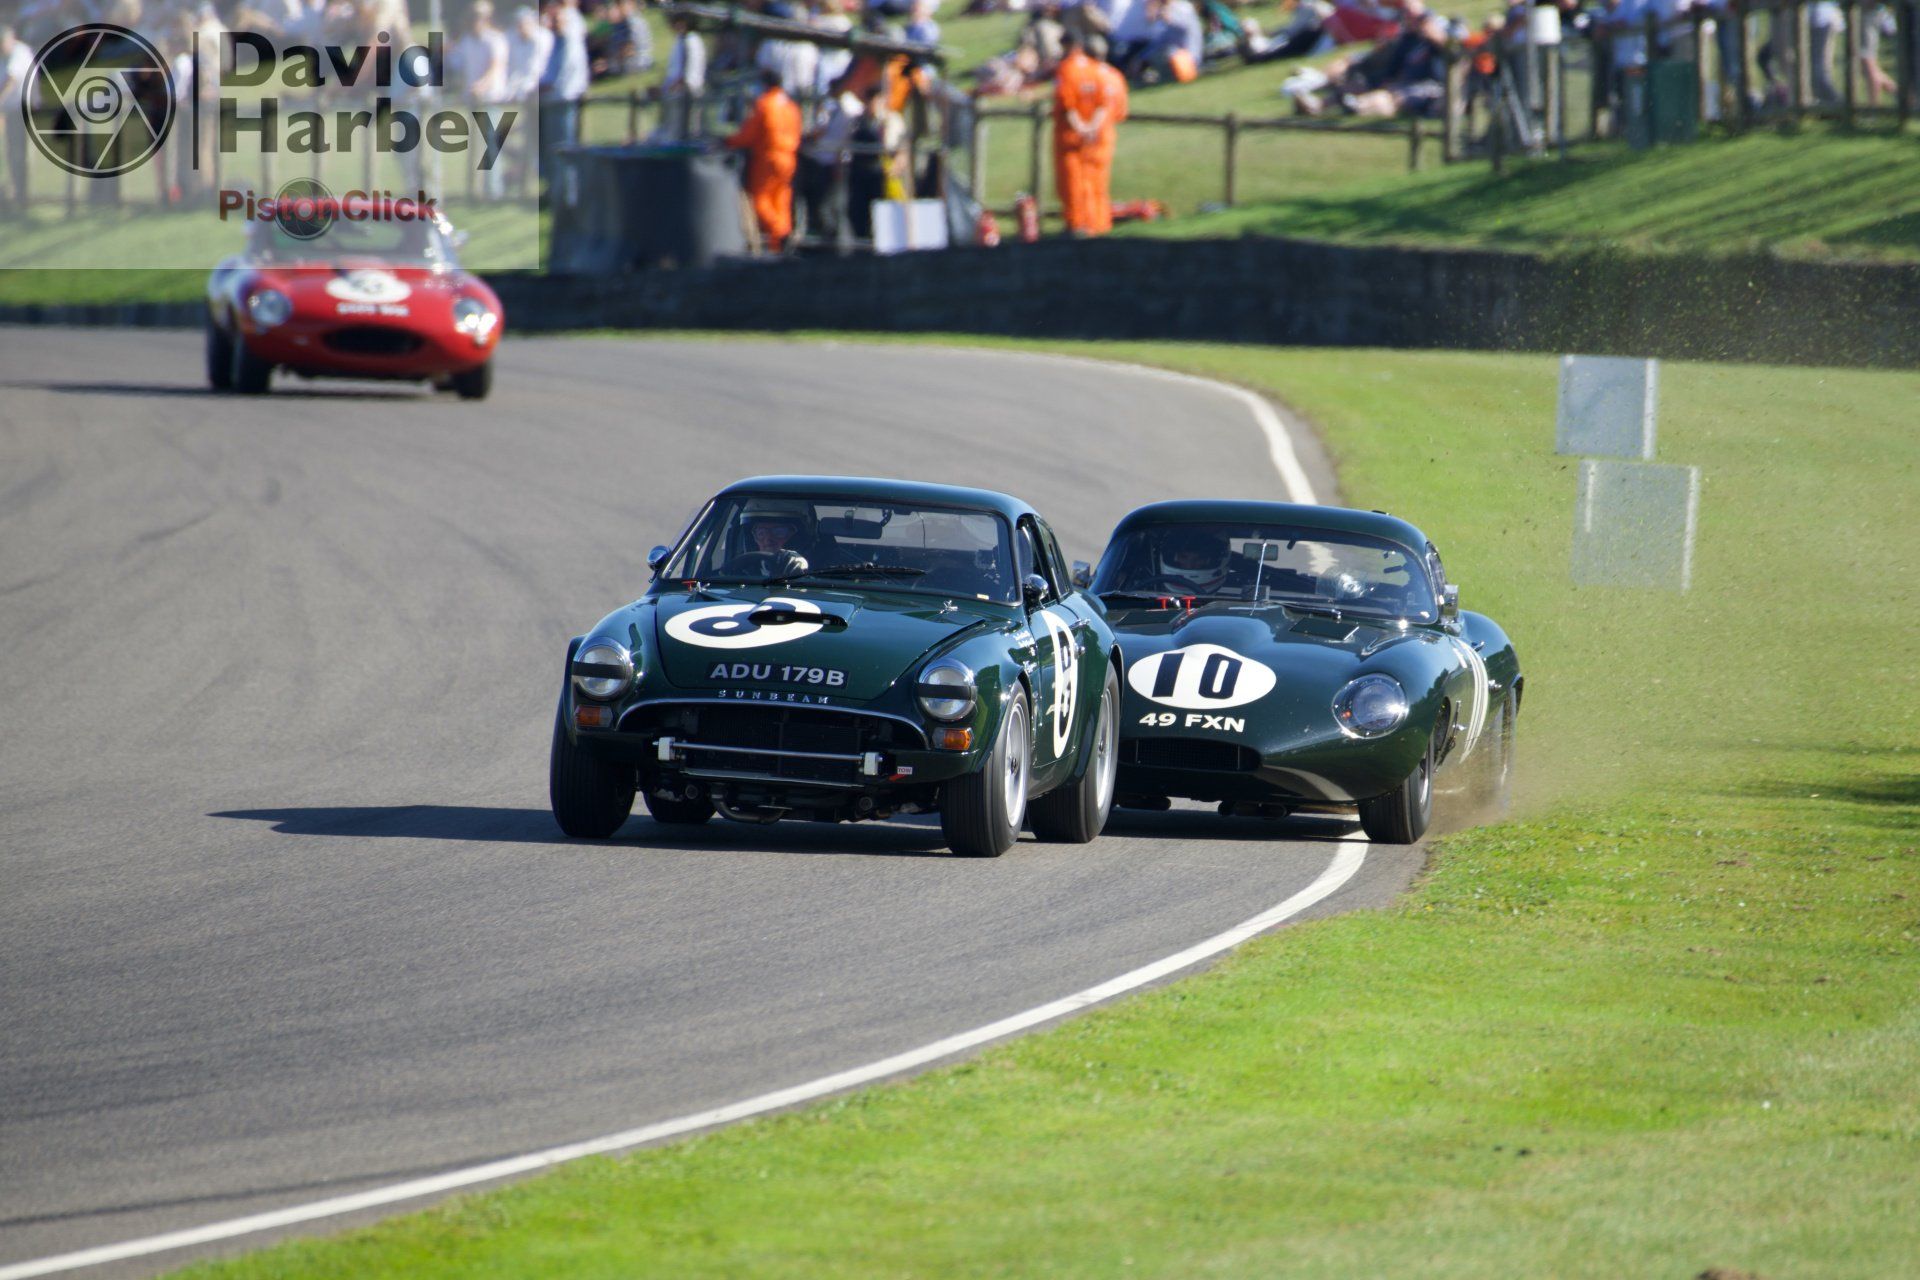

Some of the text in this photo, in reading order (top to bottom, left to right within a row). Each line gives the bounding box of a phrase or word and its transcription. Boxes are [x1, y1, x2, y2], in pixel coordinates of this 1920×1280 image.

[710, 663, 845, 686] ADU 179B
[1152, 652, 1243, 700] 10
[717, 689, 829, 704] SUNBEAM
[1139, 712, 1246, 733] 49 FXN
